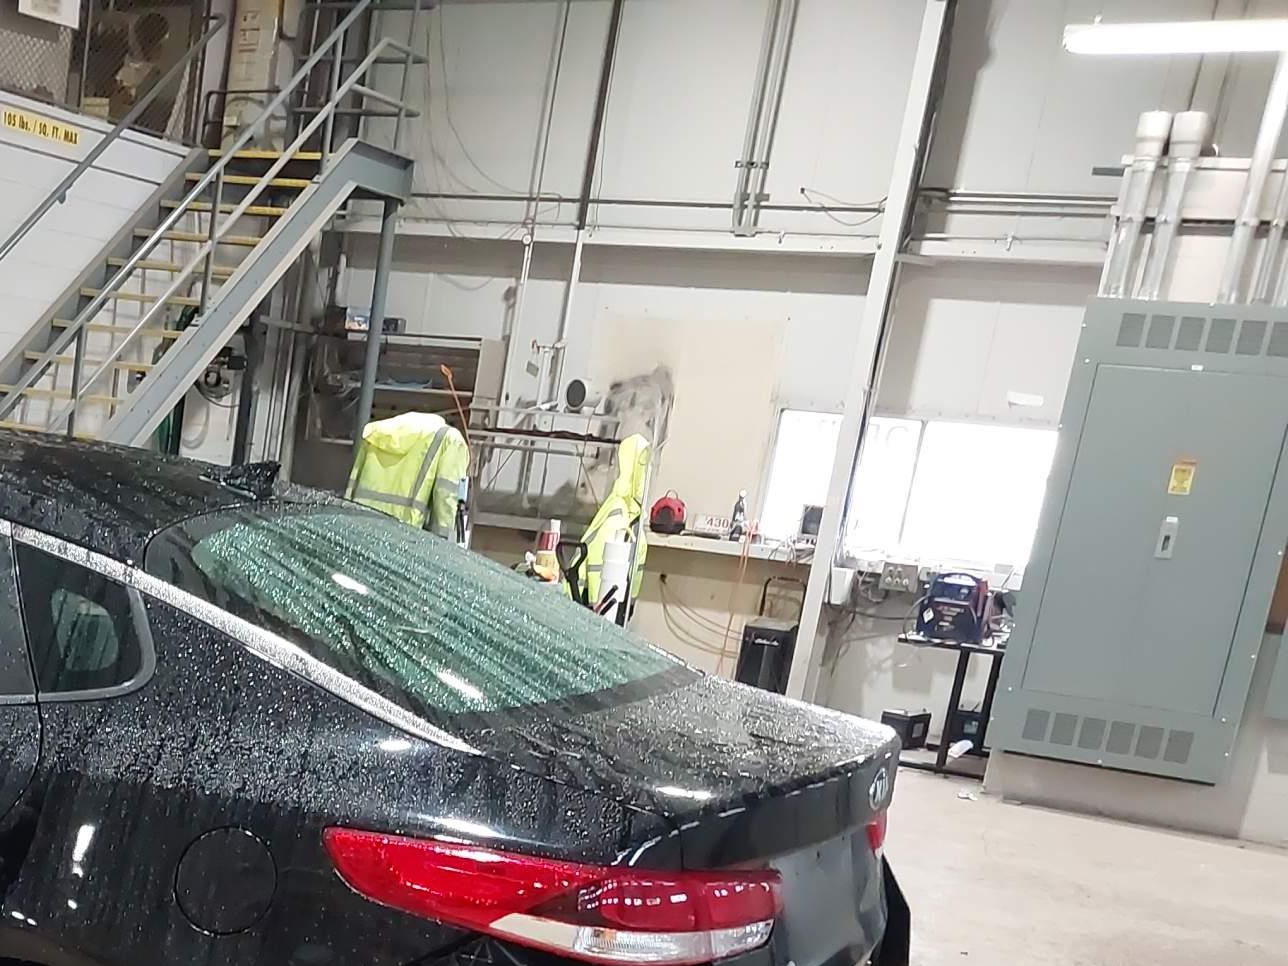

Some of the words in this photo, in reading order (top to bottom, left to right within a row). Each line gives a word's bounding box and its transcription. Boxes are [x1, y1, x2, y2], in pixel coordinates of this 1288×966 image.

[3, 111, 16, 127] 105
[18, 114, 31, 131] lbs.
[38, 121, 49, 137] SQ.
[52, 125, 61, 139] FT.
[63, 128, 78, 144] MAX
